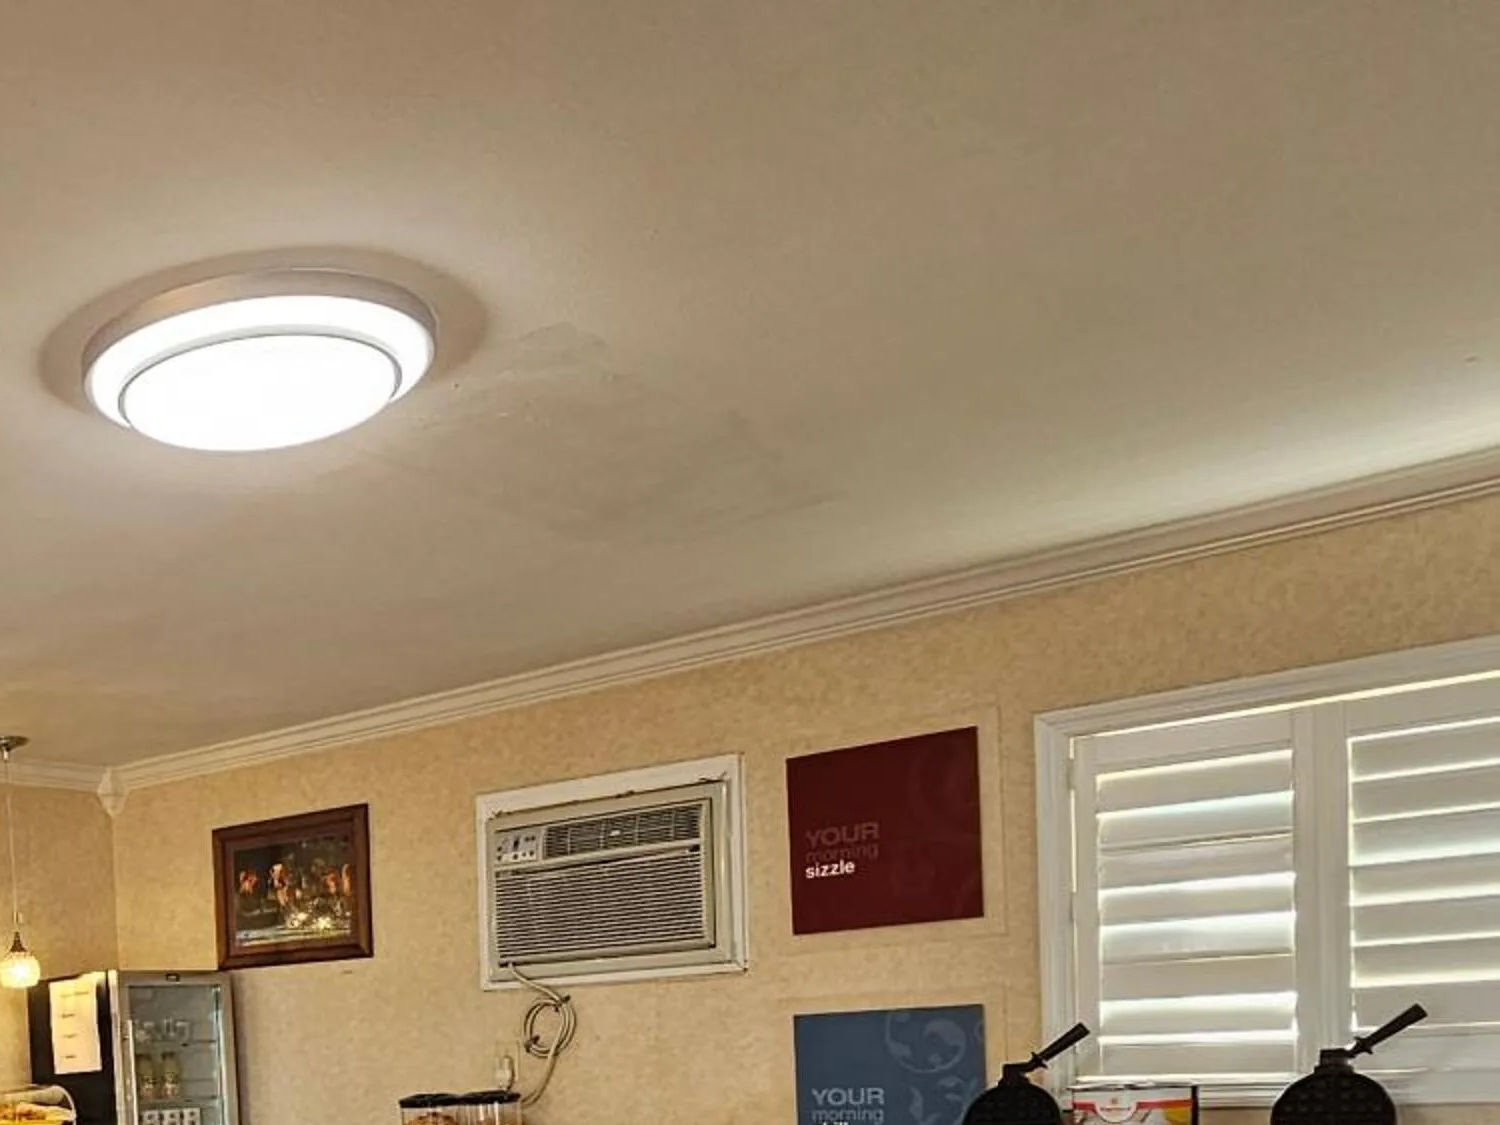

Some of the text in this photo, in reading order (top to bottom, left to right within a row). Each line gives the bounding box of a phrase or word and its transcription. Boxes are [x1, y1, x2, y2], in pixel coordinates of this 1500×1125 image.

[805, 821, 879, 849] YOUR
[805, 843, 879, 865] morning
[805, 859, 855, 879] sizzle
[811, 1087, 884, 1106] YOUR
[811, 1104, 884, 1125] morning
